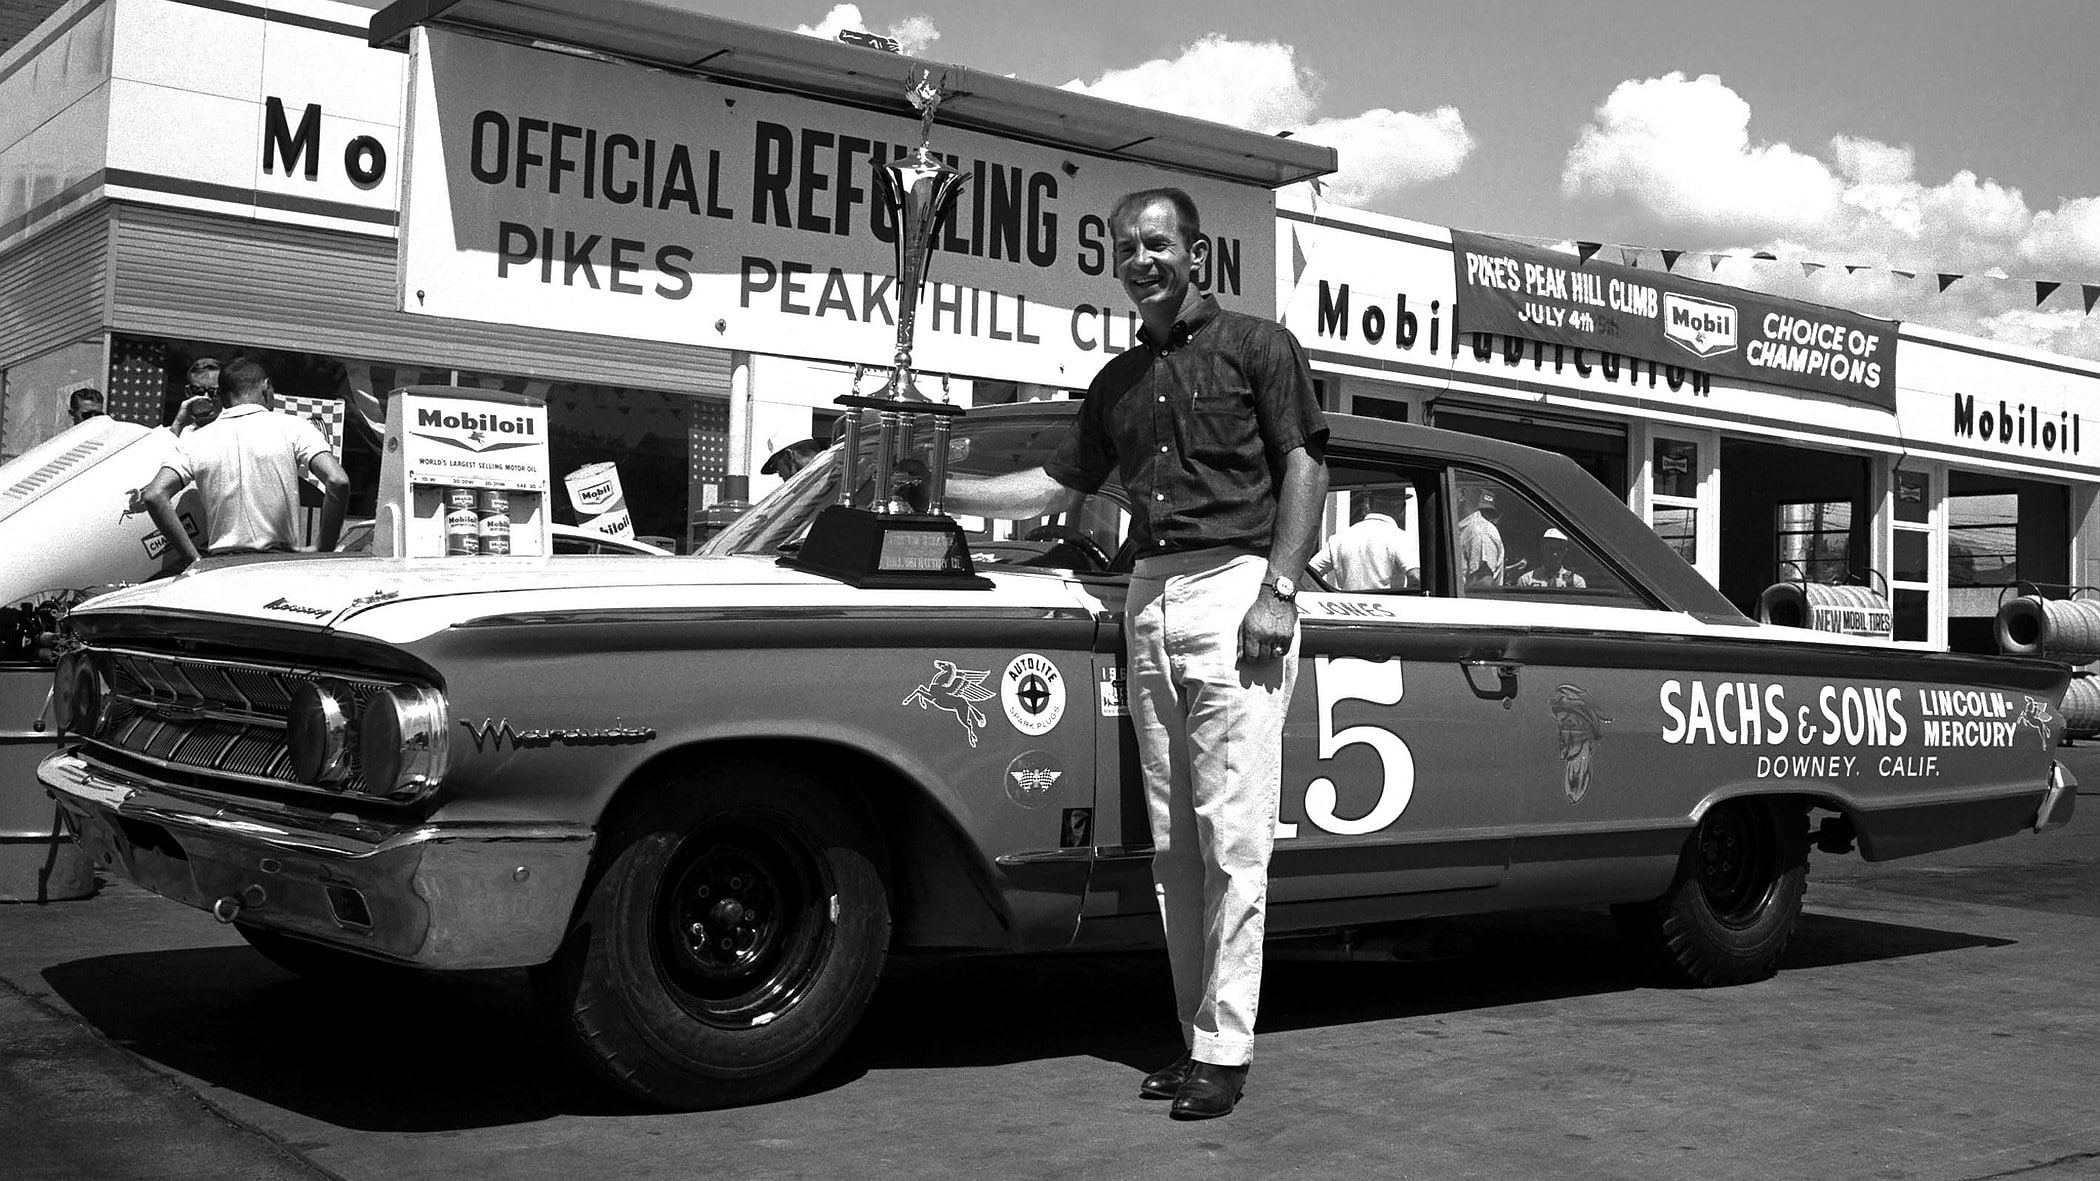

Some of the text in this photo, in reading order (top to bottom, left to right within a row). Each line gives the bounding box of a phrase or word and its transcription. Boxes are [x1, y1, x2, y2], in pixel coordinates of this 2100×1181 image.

[470, 110, 733, 220] OFFICIAL
[498, 220, 1137, 355] PIKES PEAK HILL CLI
[1466, 252, 1658, 319] PIKE'S PEAK HILL CLIMB
[1518, 302, 1565, 327] JULY
[1568, 310, 1594, 333] 4th
[1672, 306, 1730, 335] Mobil
[1763, 312, 1879, 358] CHOICE OF
[1746, 340, 1881, 388] CHAMPIONS
[418, 408, 534, 435] Mobiloil
[1955, 392, 2079, 455] Mobiloil
[419, 458, 537, 473] WORLD'S LARGEST SELLING MOTOR OIL
[582, 485, 611, 500] Mobil
[1318, 601, 1396, 617] JONES
[1815, 609, 1890, 633] NEW MOBIL TIRES
[1008, 657, 1058, 683] AUTOLITE
[1009, 705, 1060, 729] SPARK PLUGS
[1660, 679, 1907, 746] SACHS & SONS
[1919, 689, 2013, 718] LINCOLN-
[1275, 655, 1415, 838] 5
[1924, 720, 2017, 747] MERCURY
[1878, 756, 1940, 777] CALIF.
